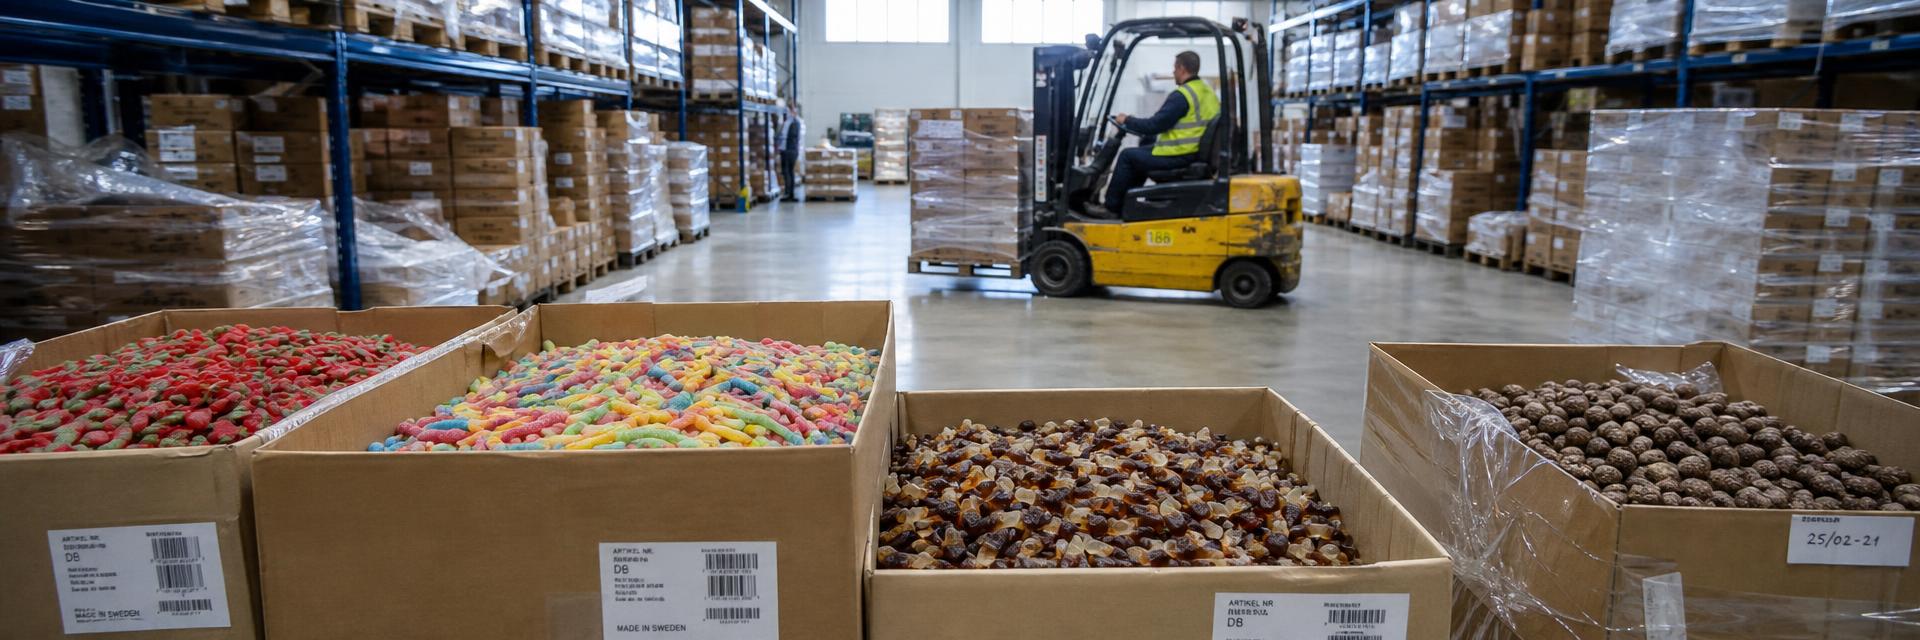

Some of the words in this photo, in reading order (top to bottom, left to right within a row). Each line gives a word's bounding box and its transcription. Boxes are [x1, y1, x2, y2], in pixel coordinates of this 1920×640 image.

[1807, 531, 1880, 548] 25/02-21
[107, 609, 140, 618] SWEDEN
[616, 624, 640, 632] MADE
[642, 624, 650, 632] IN
[651, 624, 687, 632] SWEDEN
